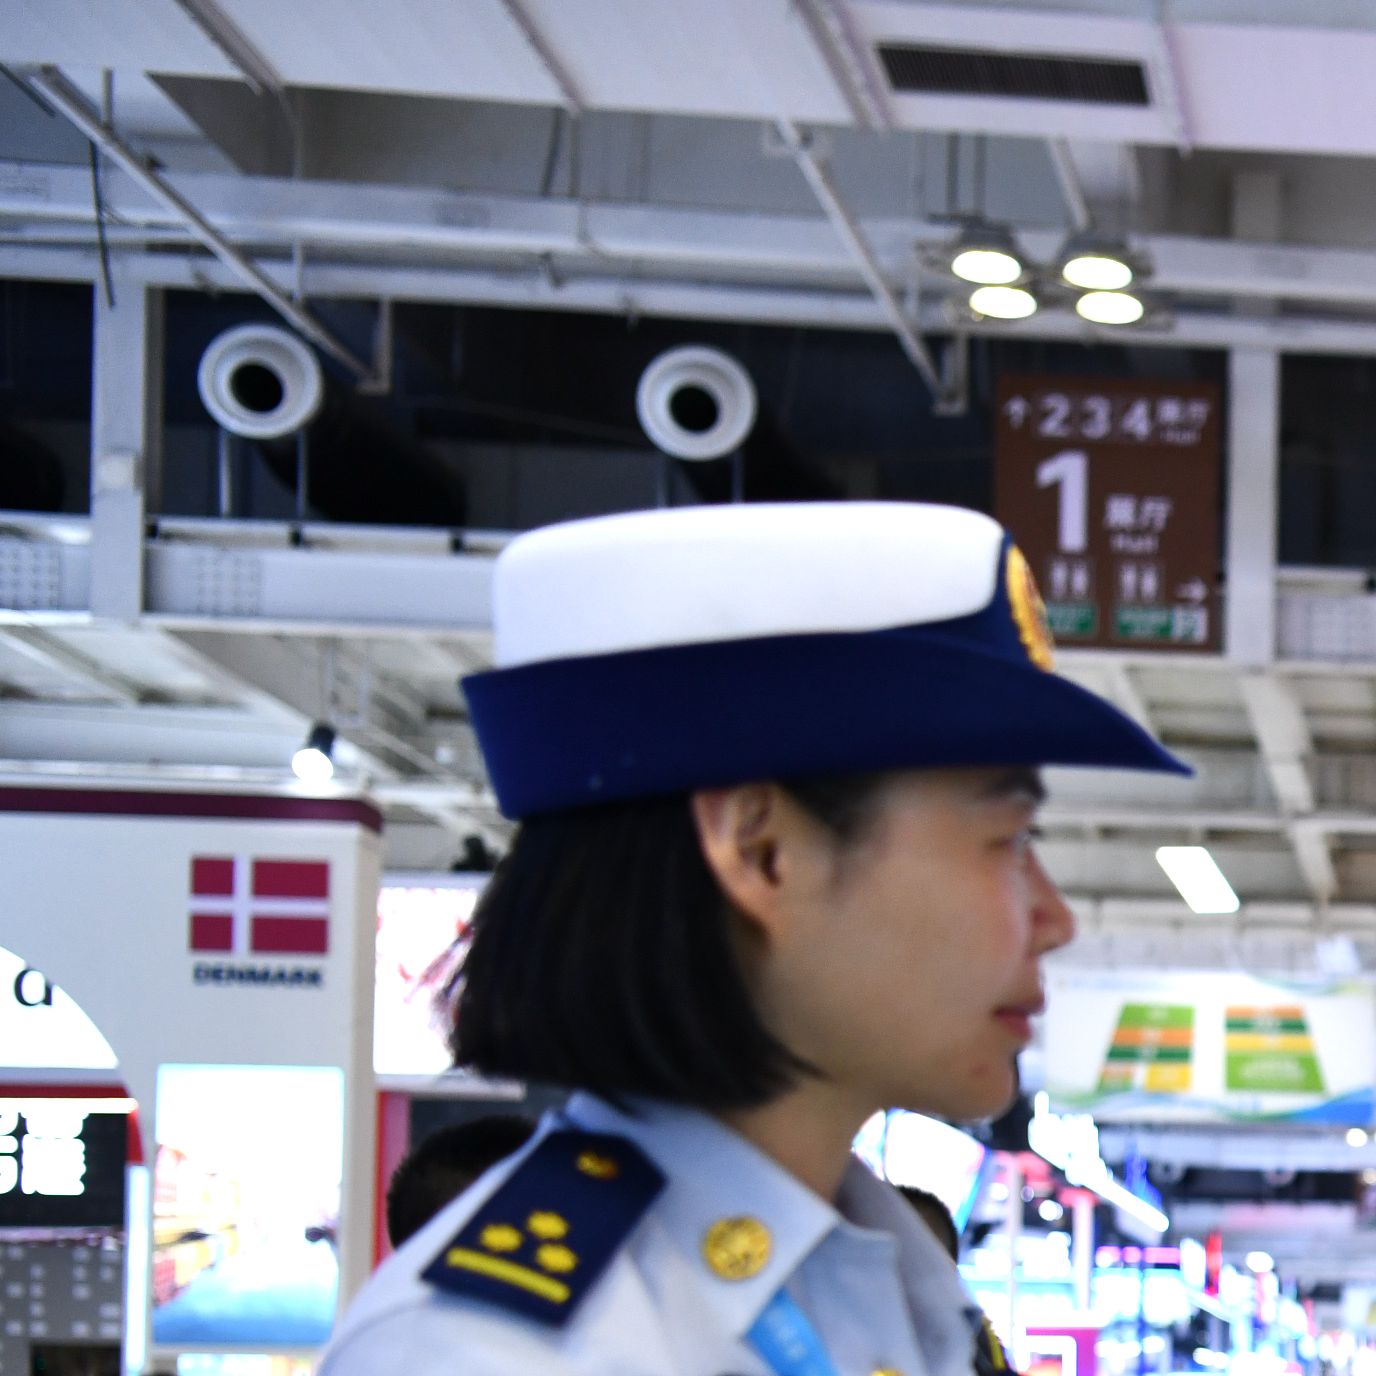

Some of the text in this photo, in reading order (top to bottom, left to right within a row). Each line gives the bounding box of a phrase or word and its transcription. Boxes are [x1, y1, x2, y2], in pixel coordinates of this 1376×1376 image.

[1037, 392, 1071, 438] 2
[1082, 395, 1112, 440] 3
[1121, 398, 1152, 441] 4
[1035, 449, 1090, 553] 1
[193, 963, 324, 988] DENMARK
